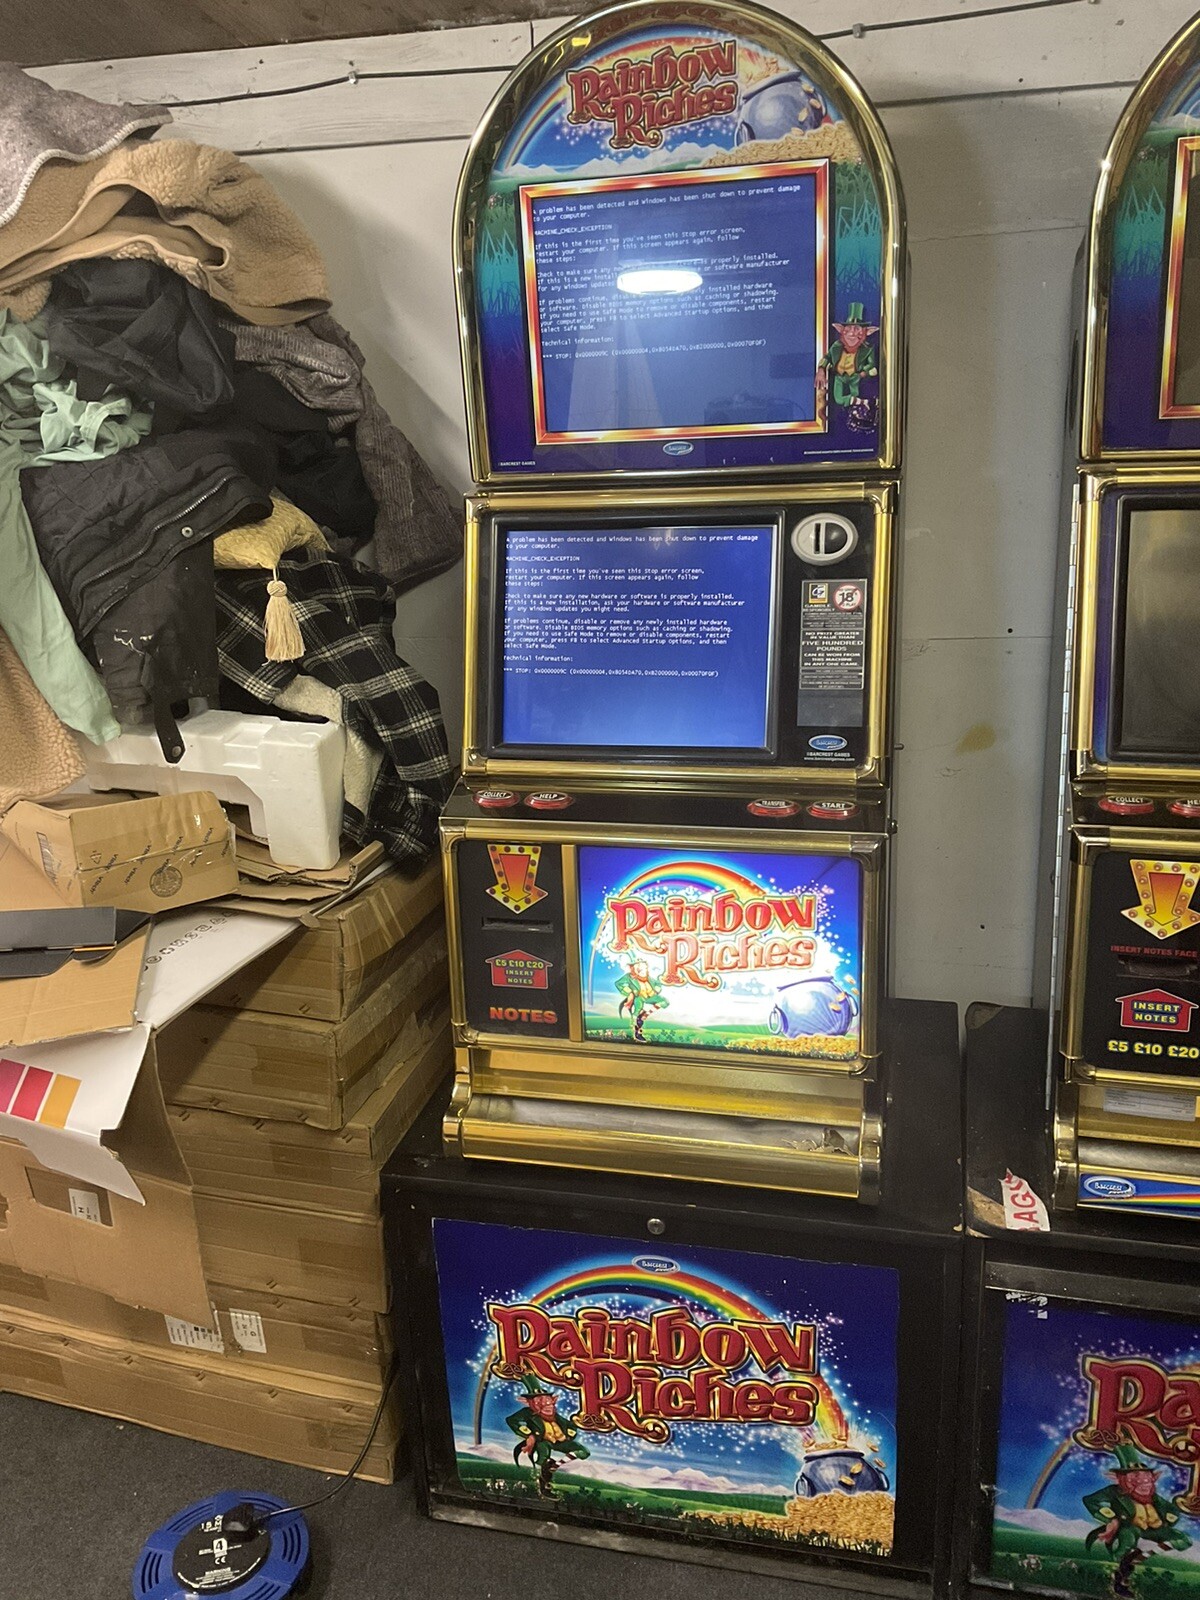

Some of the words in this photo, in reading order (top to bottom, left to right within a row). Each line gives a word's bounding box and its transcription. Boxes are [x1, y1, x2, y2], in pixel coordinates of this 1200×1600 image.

[566, 40, 737, 124] Rainbow
[609, 81, 738, 149] Riches
[539, 206, 563, 215] problem
[597, 200, 624, 208] detected
[749, 187, 774, 197] prevent
[778, 185, 800, 194] damage
[608, 890, 817, 953] Rainbow
[660, 934, 817, 990] Riches
[1144, 947, 1172, 955] NOTES
[490, 1006, 558, 1024] NOTES
[1133, 1002, 1180, 1012] INSERT
[1135, 1014, 1176, 1023] NOTES
[1108, 1040, 1128, 1052] £5
[1134, 1042, 1163, 1055] £10
[1168, 1046, 1200, 1059] £20
[486, 1301, 818, 1386] Rainbow
[569, 1358, 819, 1444] Riches
